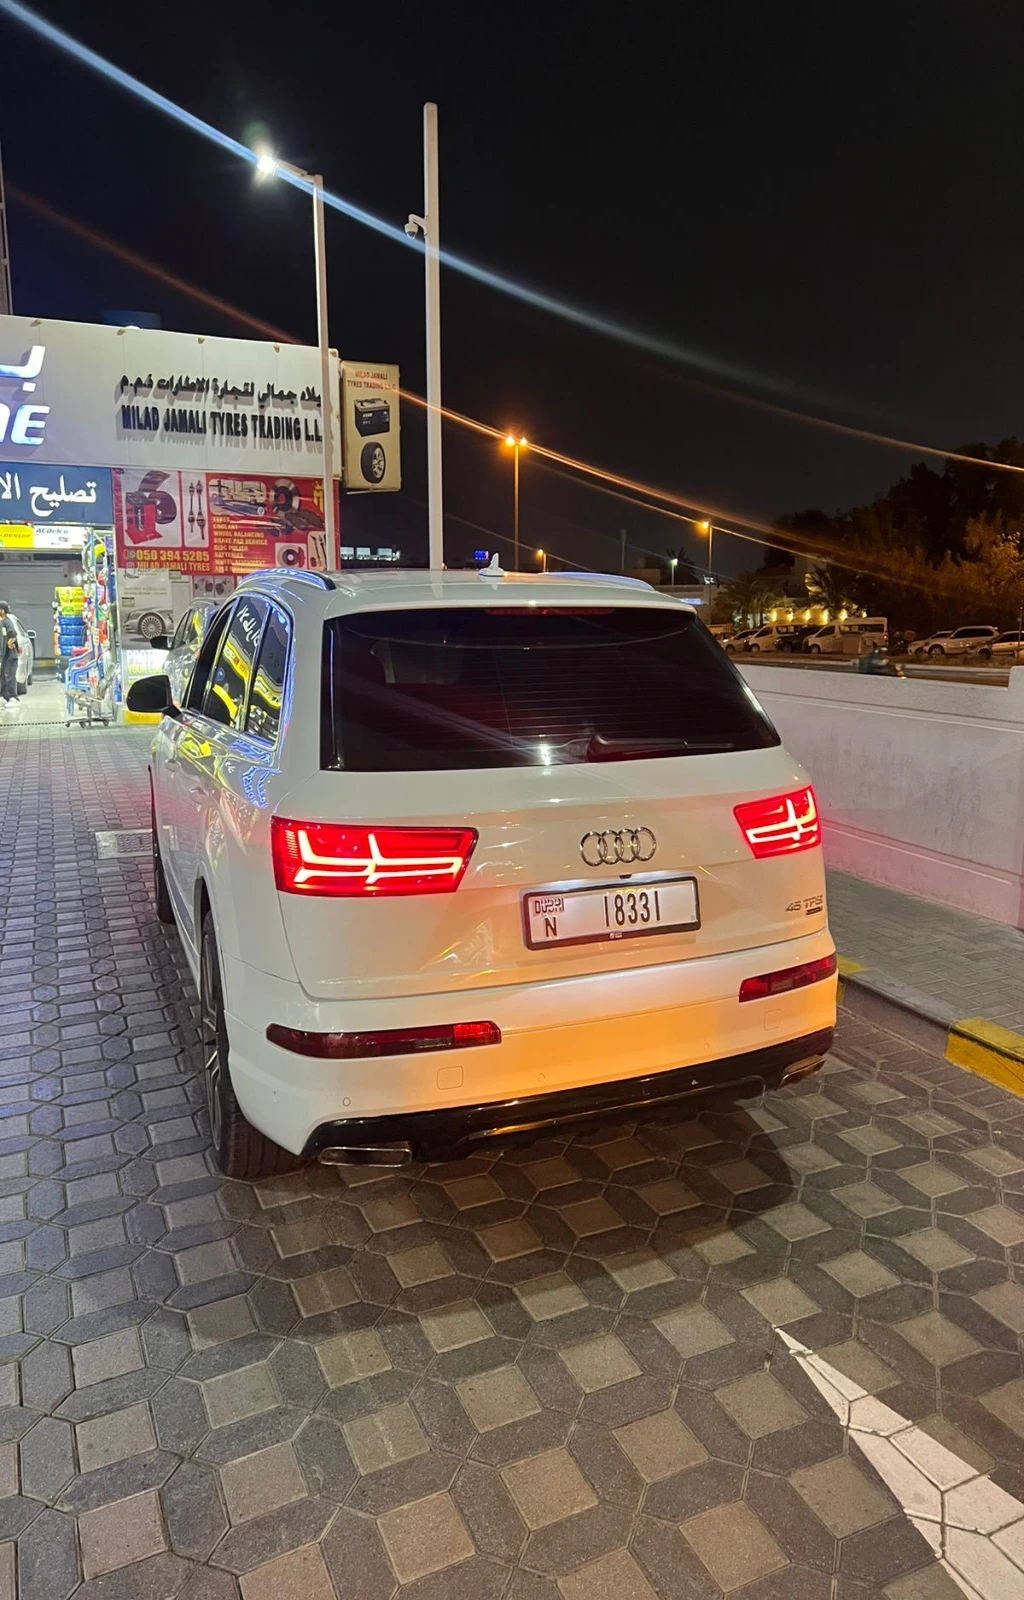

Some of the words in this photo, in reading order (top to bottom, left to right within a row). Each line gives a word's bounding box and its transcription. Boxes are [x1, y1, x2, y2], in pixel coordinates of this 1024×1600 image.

[121, 404, 160, 431] MILAD
[163, 407, 207, 434] JAMALI
[210, 410, 249, 438] TYRES
[251, 414, 302, 441] TRADING
[29, 474, 97, 517] تصليح
[159, 549, 181, 561] 394
[162, 562, 187, 572] JAMALI
[188, 562, 211, 572] TYRES
[603, 889, 661, 928] 18331
[785, 900, 802, 912] 45
[544, 916, 558, 938] N
